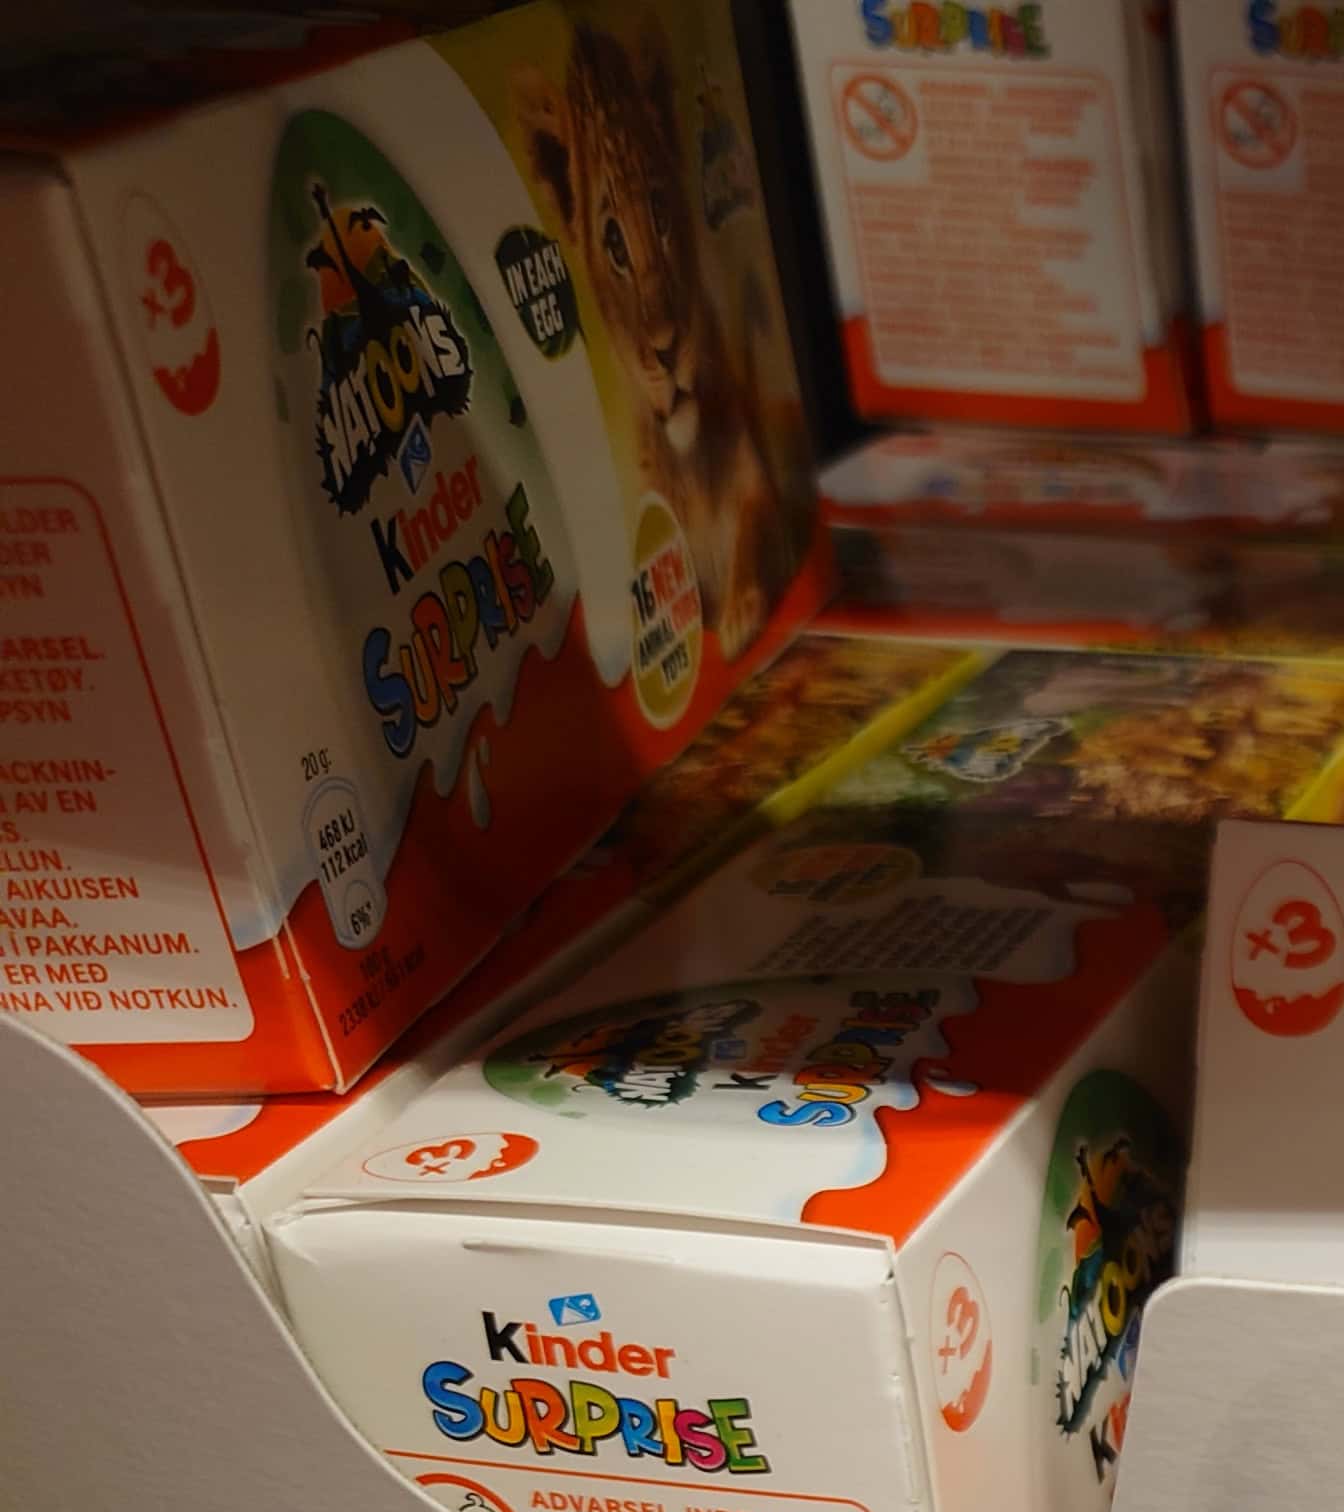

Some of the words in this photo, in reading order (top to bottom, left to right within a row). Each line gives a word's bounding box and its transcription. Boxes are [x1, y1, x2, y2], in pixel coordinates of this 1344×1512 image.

[506, 260, 529, 305] IN
[523, 243, 567, 297] EACH
[530, 292, 564, 342] EGG
[322, 303, 467, 496] NATOONS
[370, 455, 482, 595] Kinder
[363, 482, 554, 759] SURPRISE
[55, 790, 97, 813] EN
[7, 877, 140, 901] AIKUISEN
[320, 848, 348, 884] 112
[25, 932, 200, 957] PAKKANUM.
[3, 962, 41, 985] ER
[44, 961, 109, 985] MEÐ
[55, 990, 103, 1011] VIÐ
[109, 987, 238, 1009] NOTKUN.
[482, 1311, 677, 1379] Kinder
[423, 1360, 771, 1474] SURPRISE
